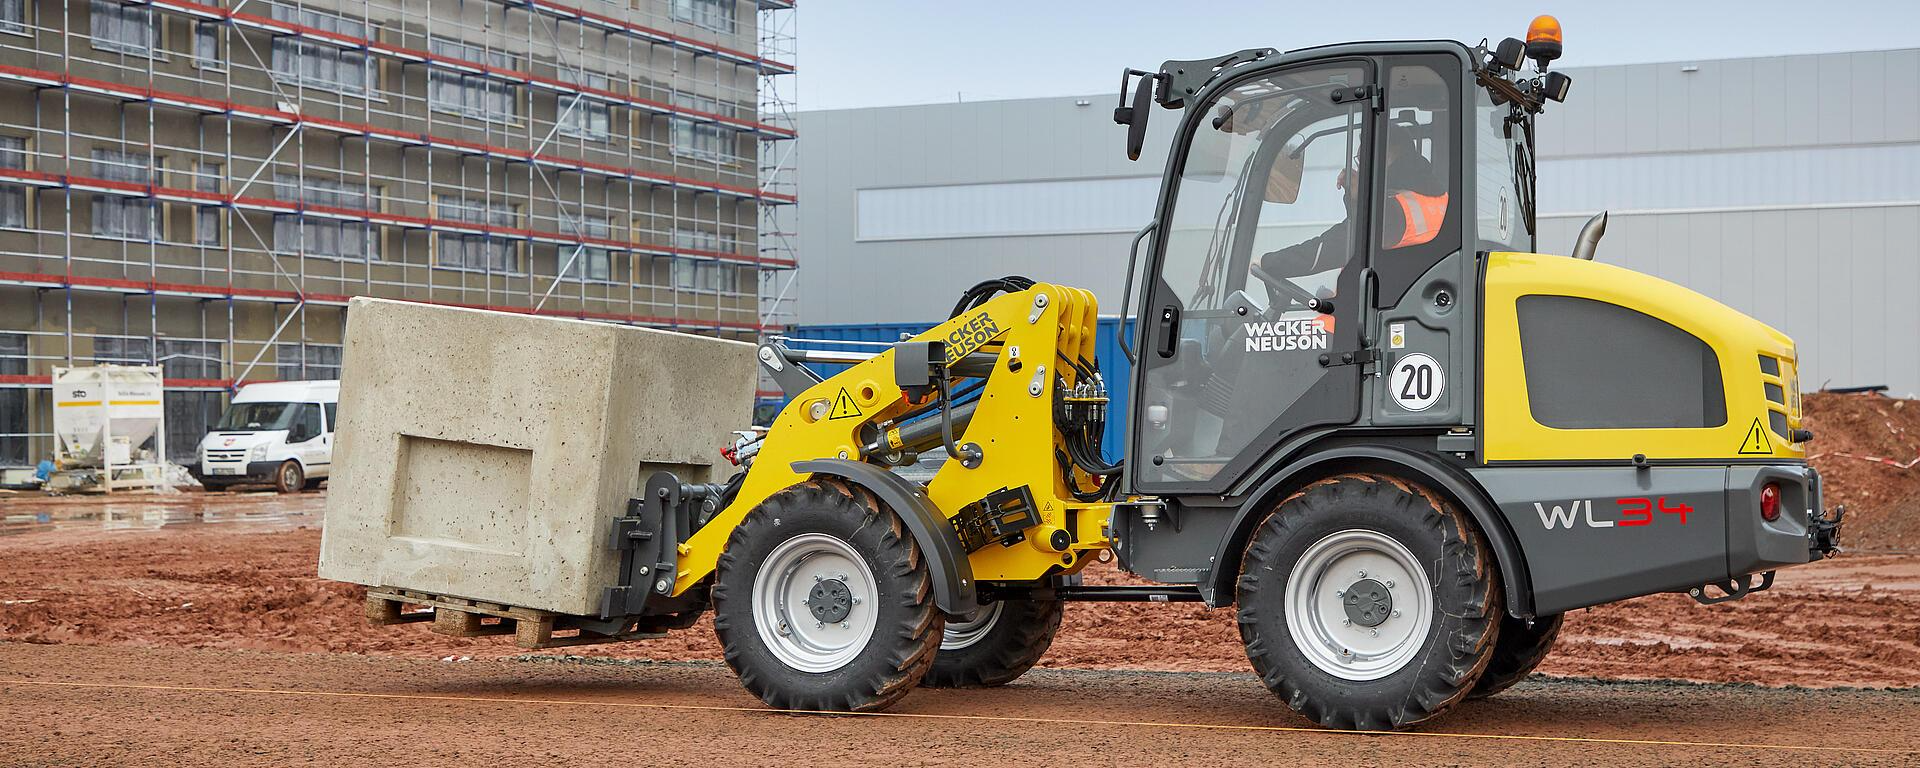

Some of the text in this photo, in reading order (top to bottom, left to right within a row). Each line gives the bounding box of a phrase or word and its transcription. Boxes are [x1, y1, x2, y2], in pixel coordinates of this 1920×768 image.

[942, 311, 993, 348] ACKER
[945, 321, 1000, 363] EUSON
[1244, 320, 1327, 337] WACKER
[1245, 334, 1327, 352] NEUSON
[1400, 364, 1433, 400] 20
[1533, 496, 1694, 530] WL34
